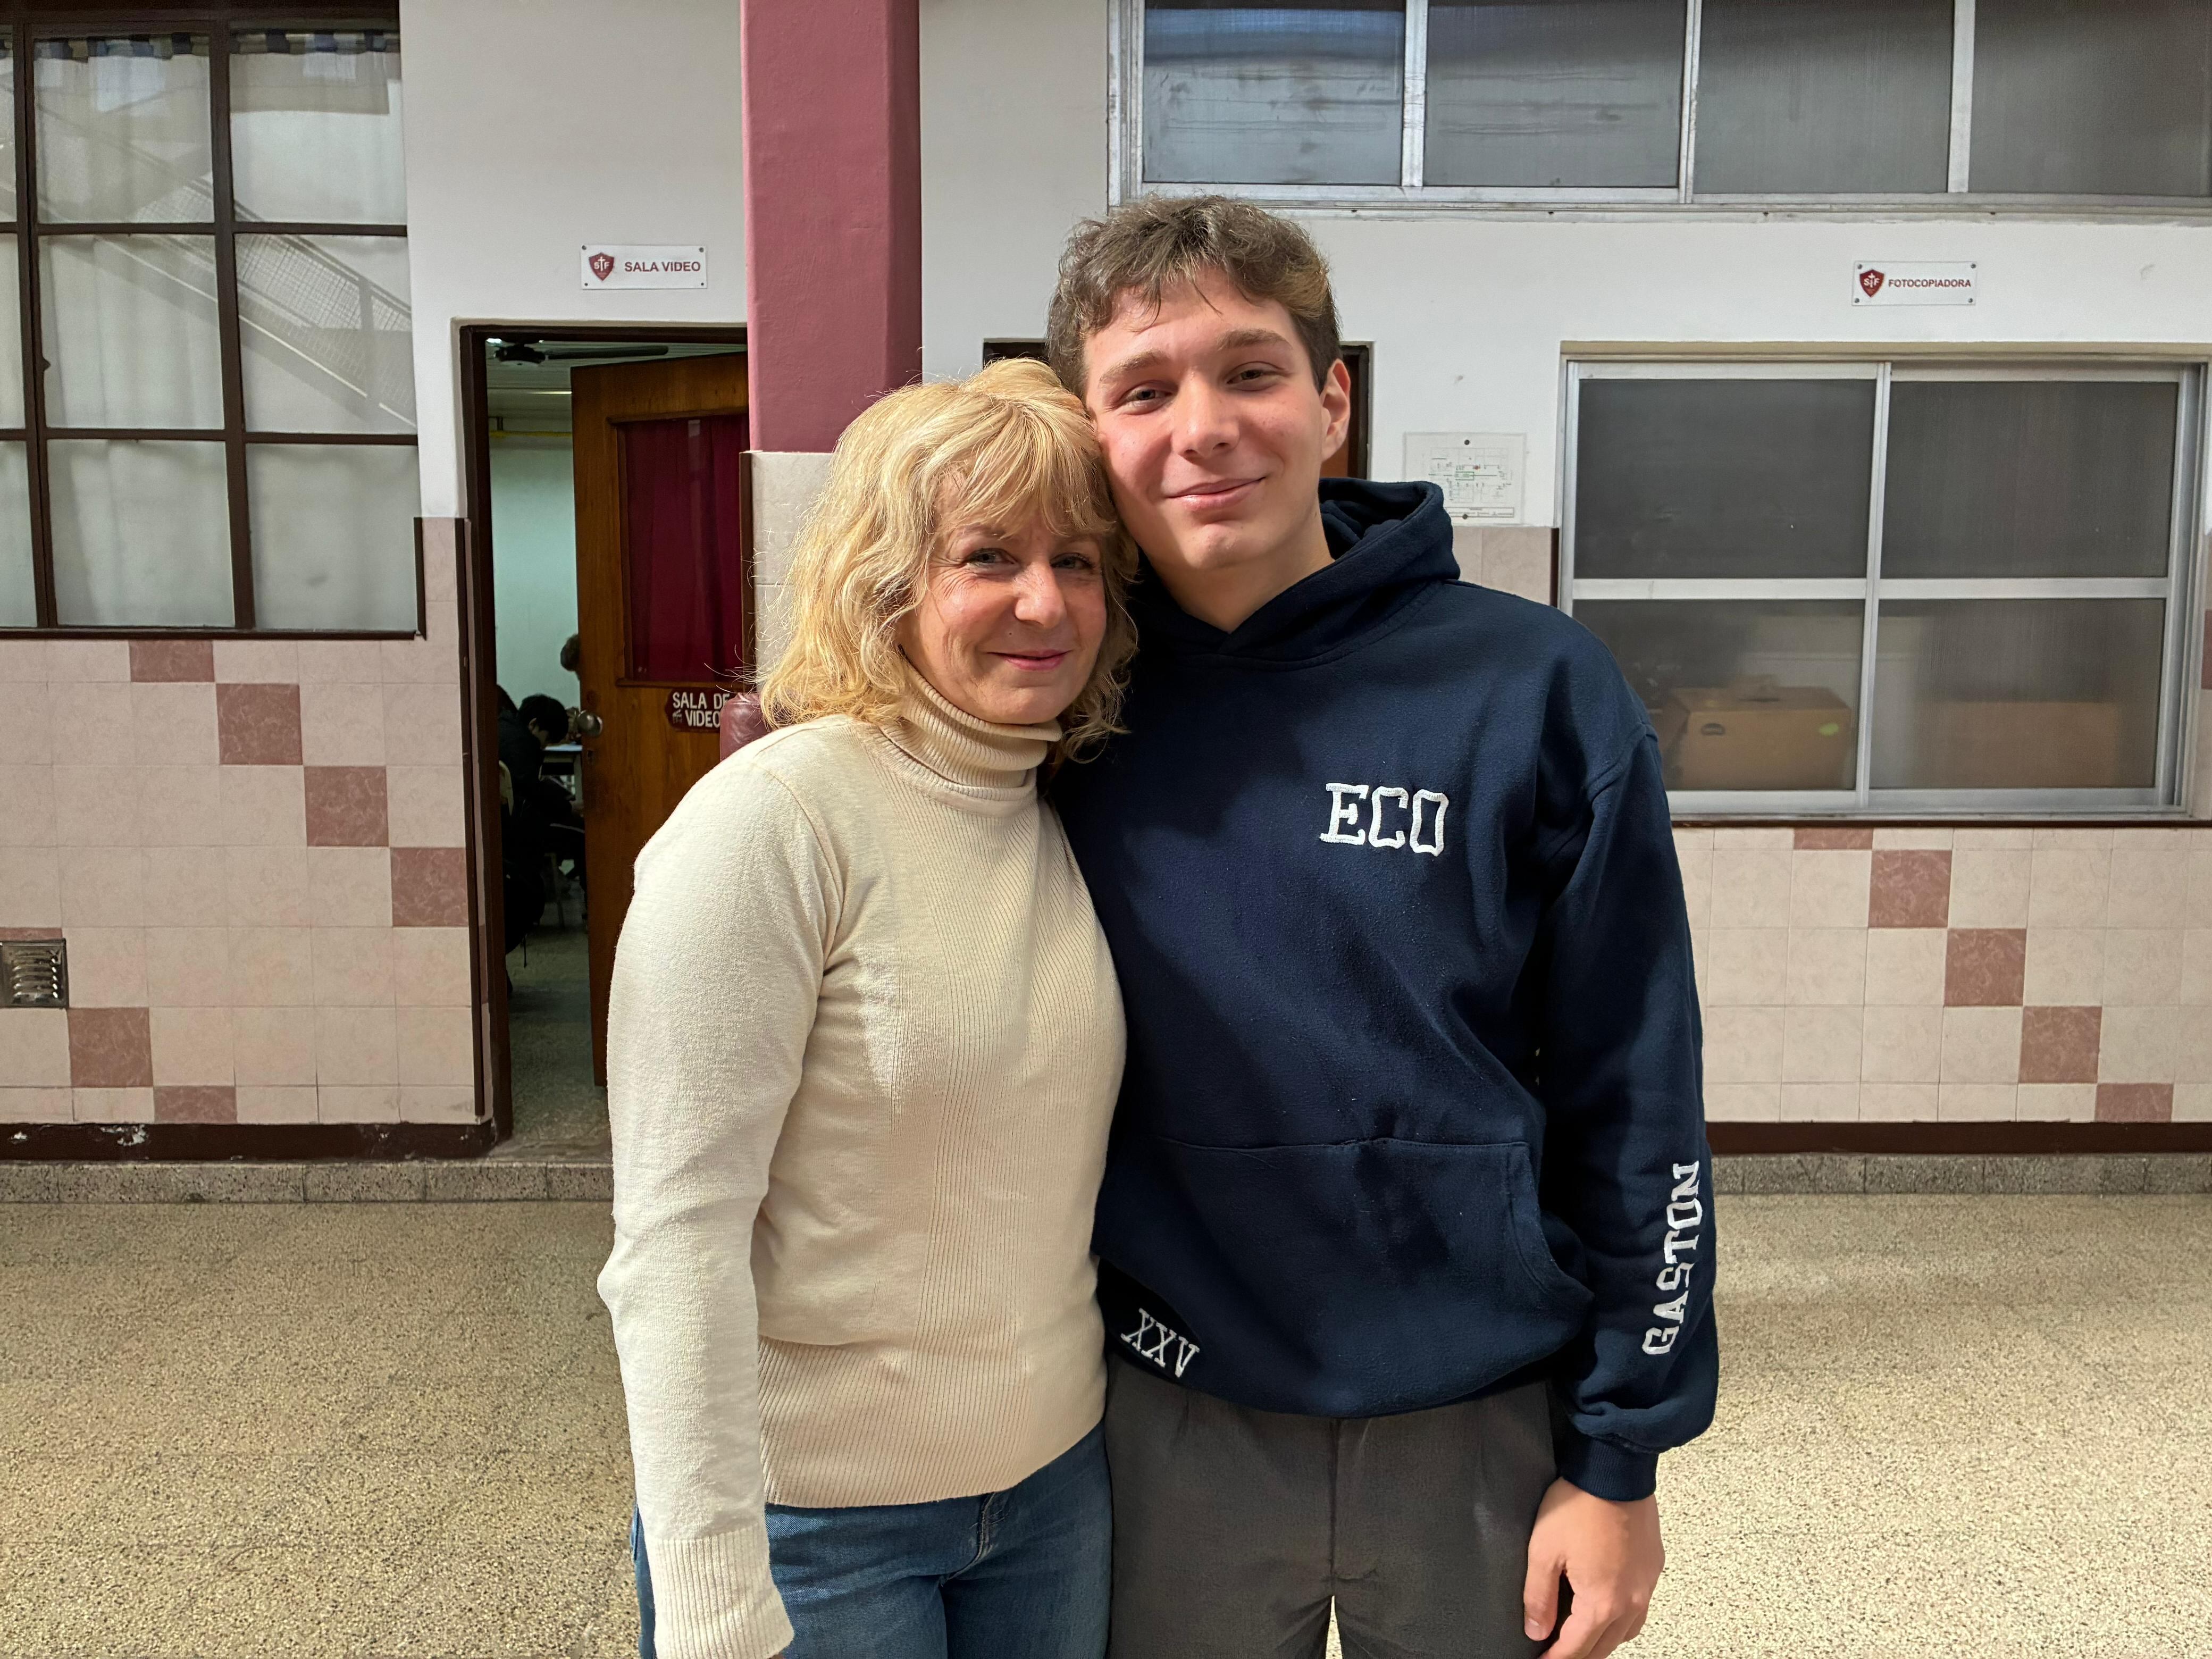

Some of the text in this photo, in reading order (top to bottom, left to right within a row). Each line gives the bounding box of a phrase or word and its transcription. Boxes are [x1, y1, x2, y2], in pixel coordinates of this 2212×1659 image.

[624, 261, 701, 272] SALA VIDEO
[1888, 279, 1972, 288] FOTOCOPIADORA
[672, 692, 707, 709] SALA
[684, 710, 720, 728] VIDEO
[1319, 783, 1449, 857] ECO
[1642, 1160, 1703, 1355] GASTON
[1120, 1308, 1200, 1378] XXV
